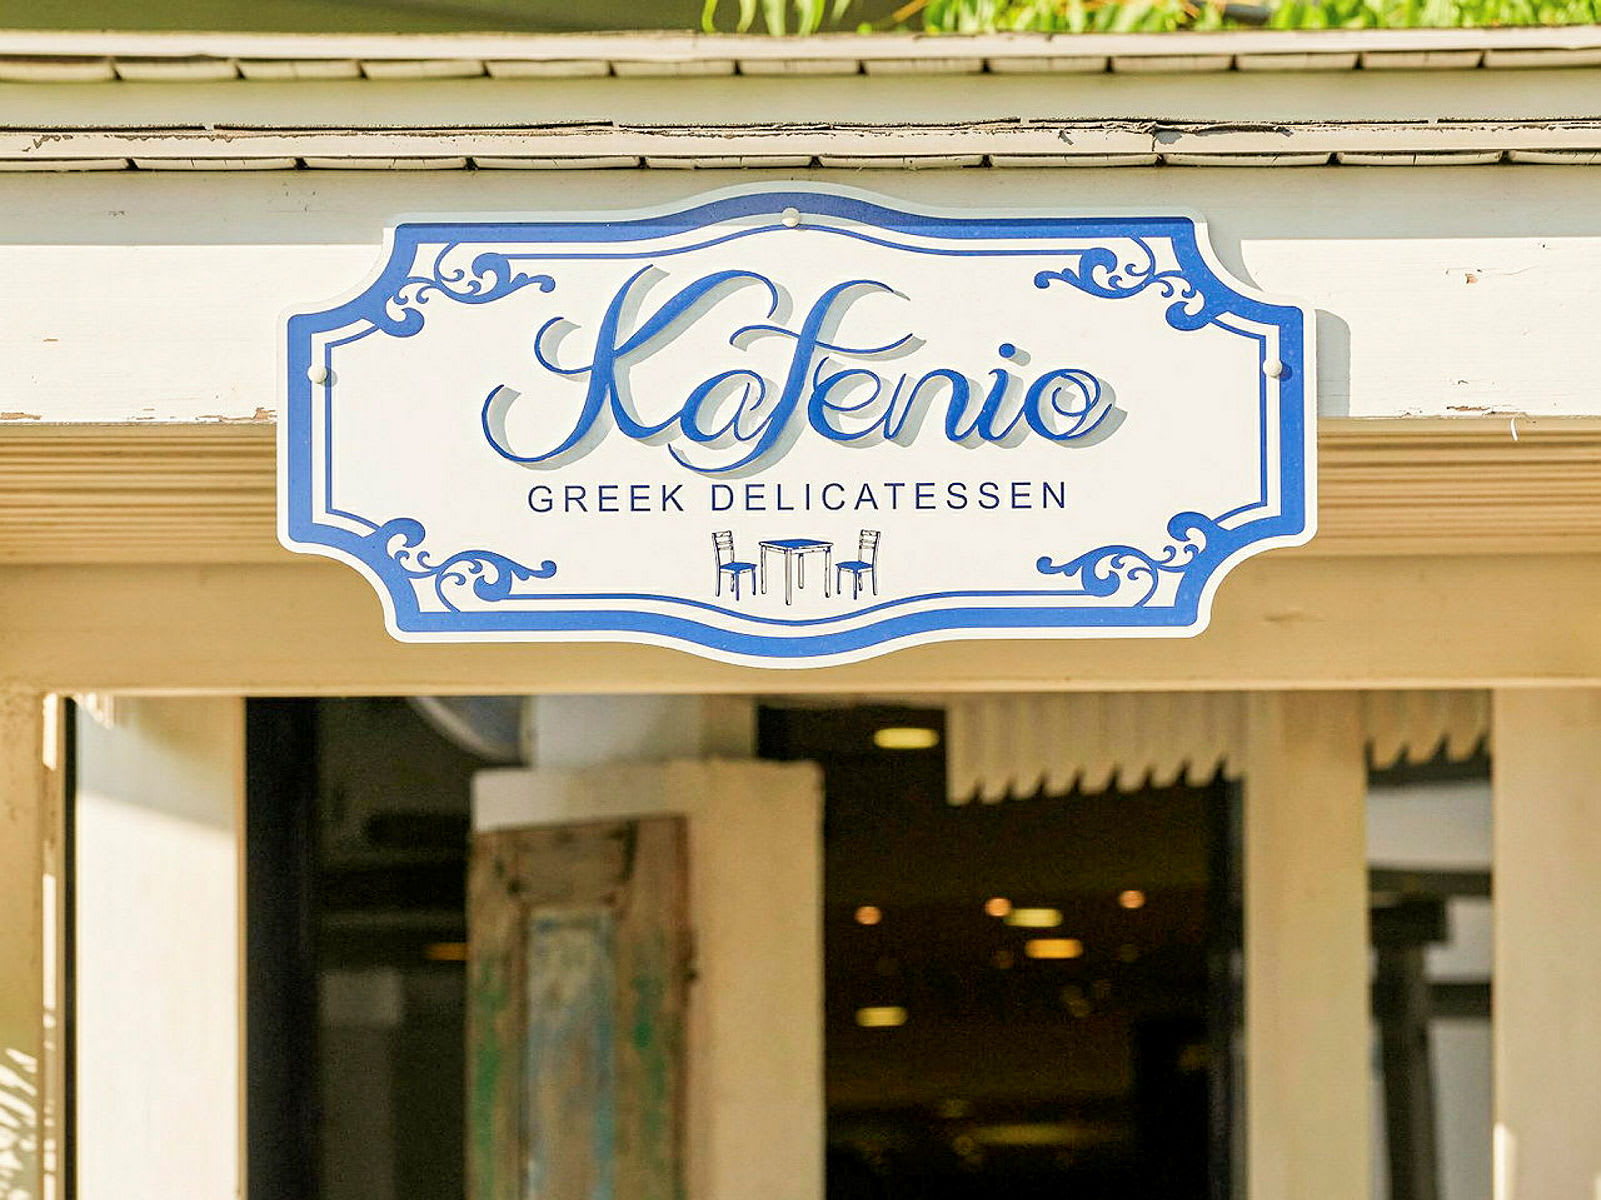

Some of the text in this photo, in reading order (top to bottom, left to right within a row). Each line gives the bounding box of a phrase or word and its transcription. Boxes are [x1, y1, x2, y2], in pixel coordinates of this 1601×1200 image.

[481, 264, 1112, 473] Kafenio
[527, 480, 1065, 513] GREEK DELICATESSEN
